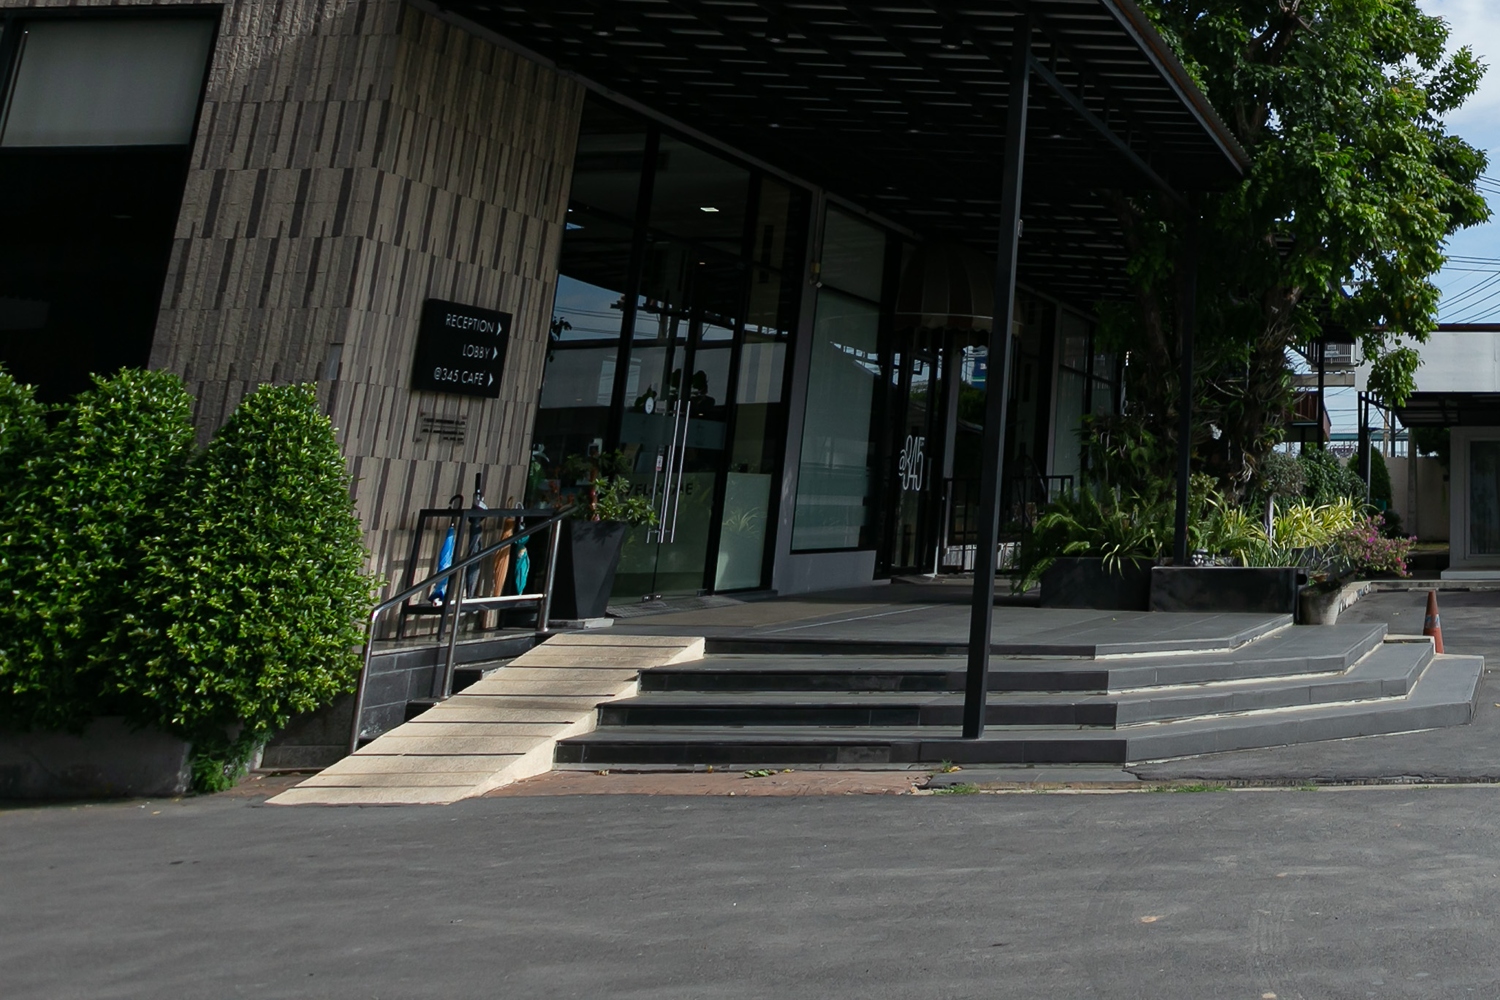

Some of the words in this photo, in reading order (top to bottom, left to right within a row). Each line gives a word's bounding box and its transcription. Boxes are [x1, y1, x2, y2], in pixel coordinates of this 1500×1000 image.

[446, 313, 495, 333] RECEPTION
[462, 344, 490, 359] LOBBY
[434, 367, 459, 382] @345
